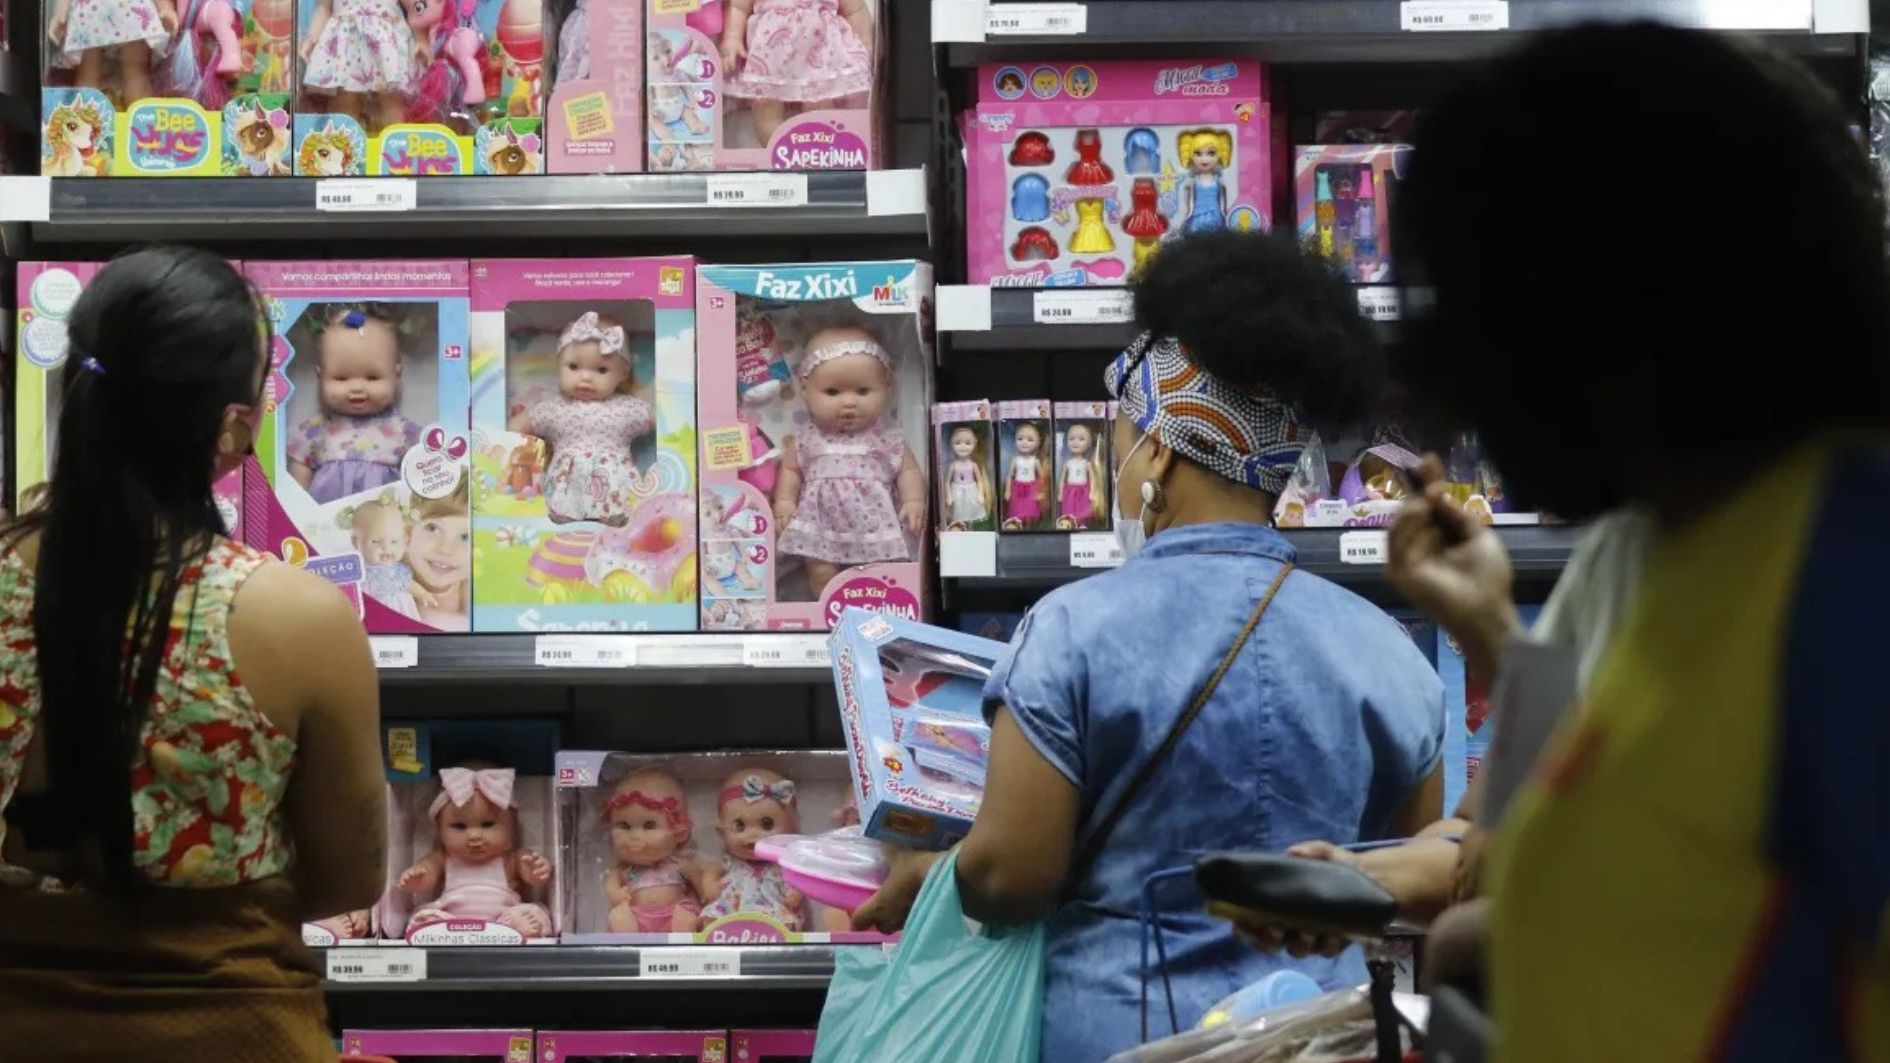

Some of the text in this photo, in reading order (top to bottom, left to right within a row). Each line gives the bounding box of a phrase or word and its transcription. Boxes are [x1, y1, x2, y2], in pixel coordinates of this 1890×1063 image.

[154, 108, 197, 132] Bee
[790, 131, 835, 145] Faz Xixi
[407, 134, 447, 157] Bee
[775, 146, 865, 169] SAPEKINHA
[281, 271, 452, 284] Vamos compartilhar lindos momentos
[755, 270, 858, 300] Faz Xixi
[416, 455, 443, 470] Quero
[434, 471, 450, 479] seu
[843, 586, 888, 600] Faz Xixi
[561, 769, 573, 778] 3+
[449, 922, 483, 931] COLEÇÃO
[414, 934, 464, 944] Milkinhas
